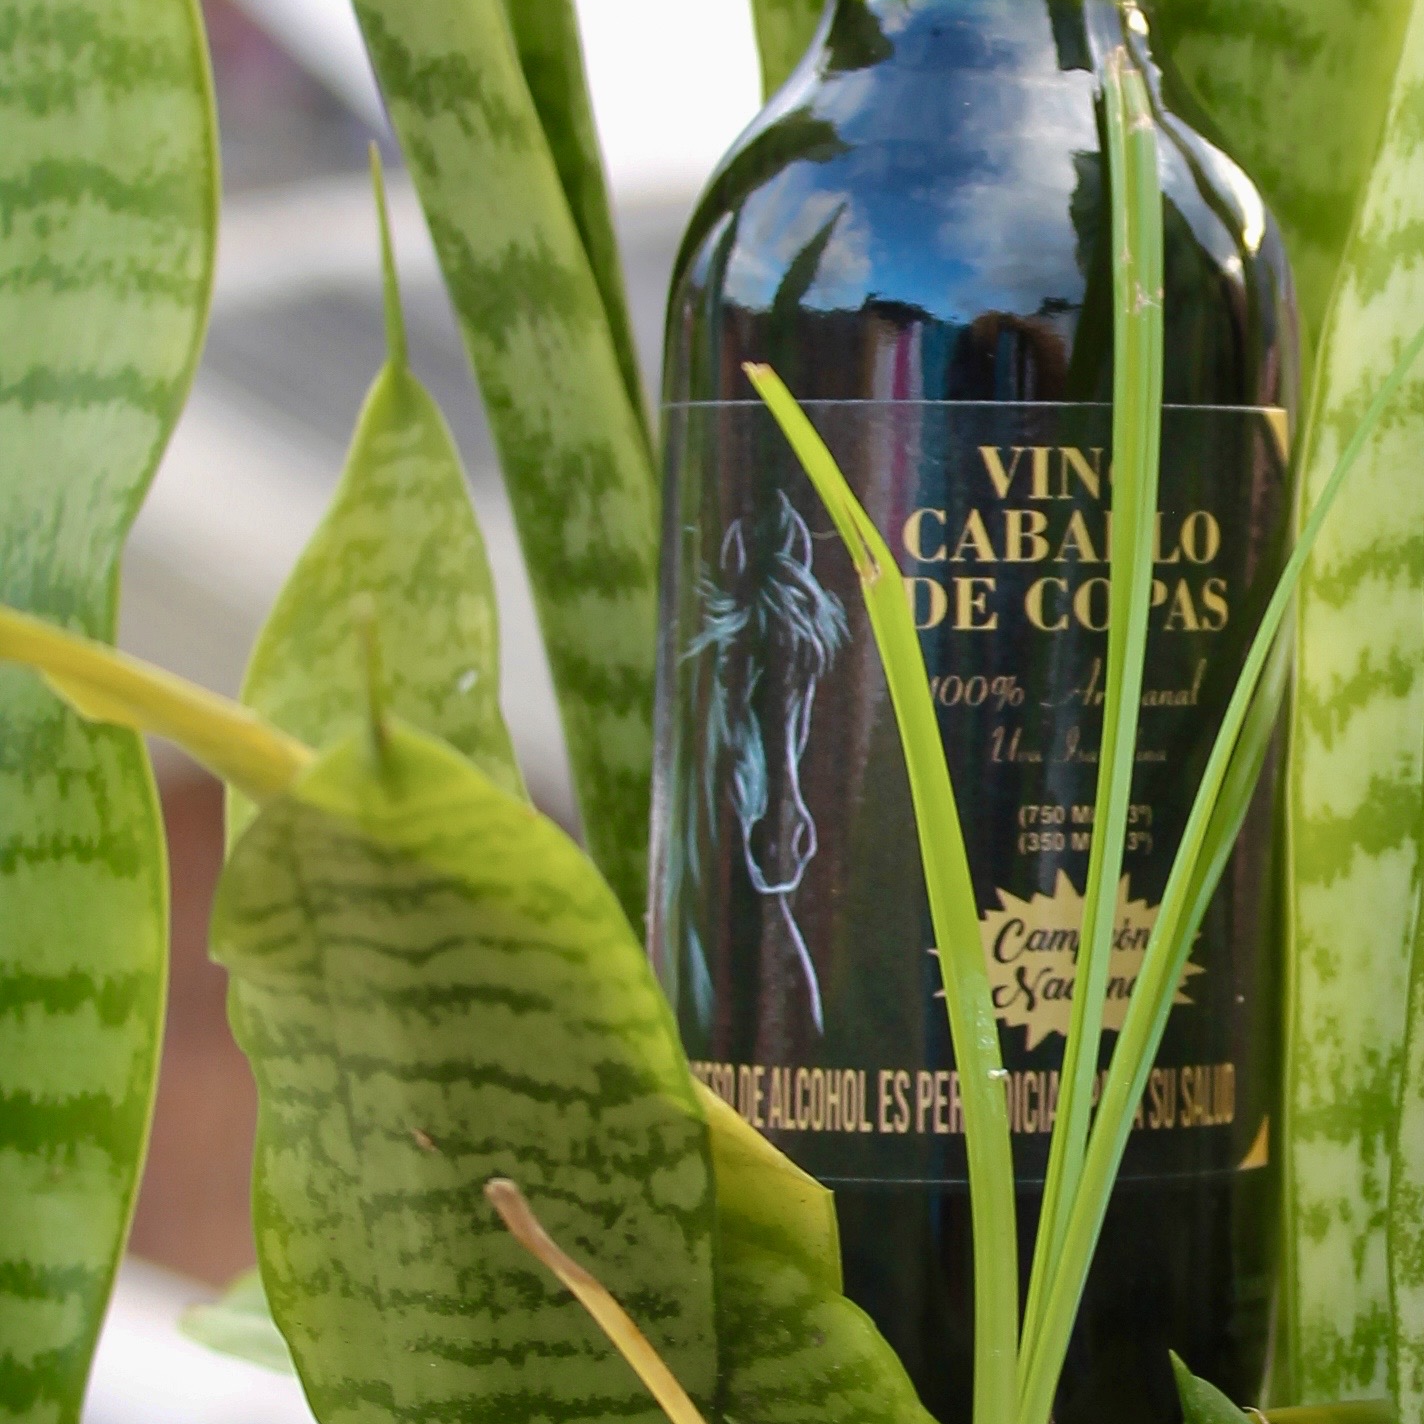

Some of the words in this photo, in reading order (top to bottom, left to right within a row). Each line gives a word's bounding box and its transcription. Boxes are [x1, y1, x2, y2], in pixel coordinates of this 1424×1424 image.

[978, 445, 1113, 501] VIN
[902, 507, 1221, 564] CABALO
[902, 577, 999, 631] DE
[1040, 657, 1208, 707] Aranal
[1018, 804, 1066, 829] (750
[1018, 831, 1066, 856] (350
[767, 1066, 874, 1133] ALCOHOL
[877, 1070, 912, 1134] ES
